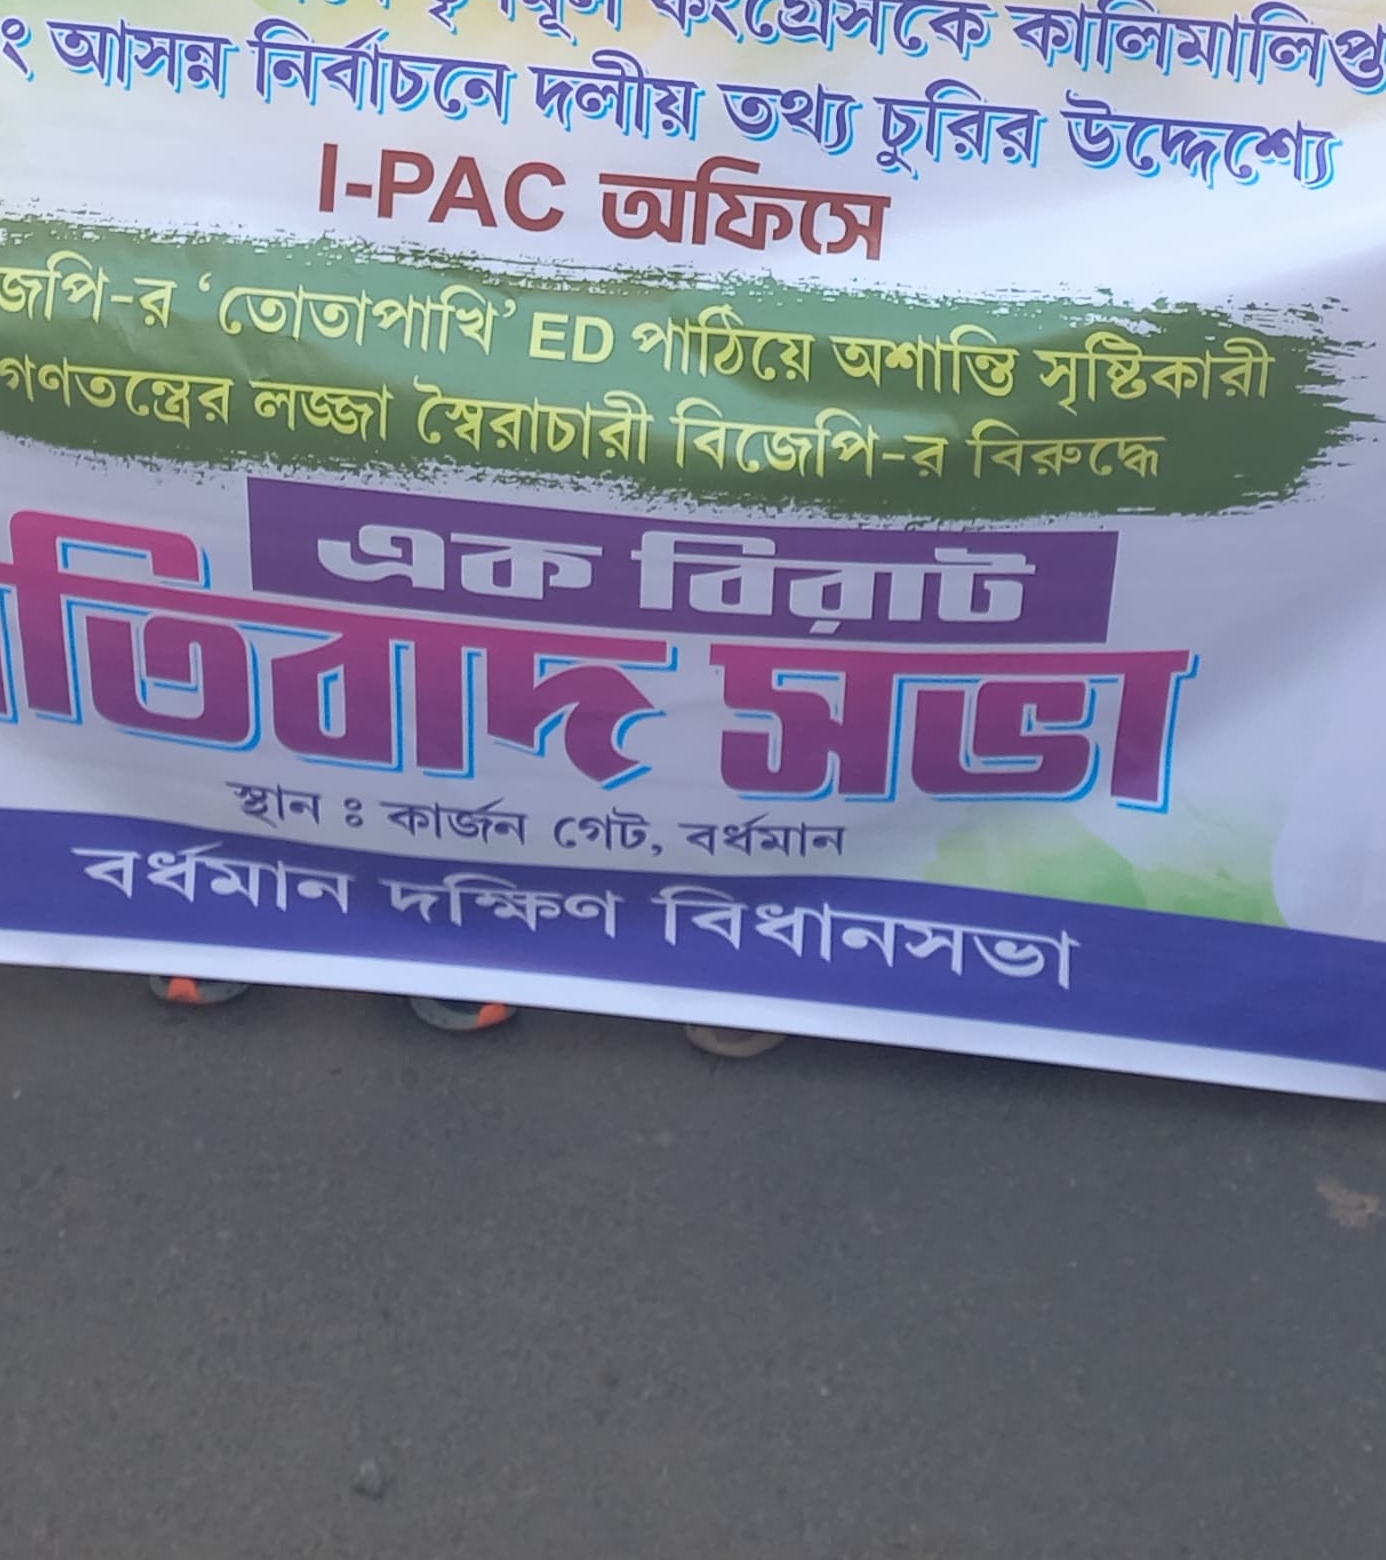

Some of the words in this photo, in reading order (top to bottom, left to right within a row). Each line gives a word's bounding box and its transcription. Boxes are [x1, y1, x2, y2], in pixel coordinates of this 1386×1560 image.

[46, 18, 240, 100] আসন্ন
[246, 15, 516, 123] নির্বাচনে
[528, 49, 706, 142] দলীয়
[716, 81, 862, 153] তথ্য
[874, 77, 1048, 181] চুরির
[1060, 89, 1344, 190] উদ্দেশ্যে
[318, 141, 566, 233] I-PAC
[599, 155, 892, 262] অফিসে
[529, 311, 615, 364] ED
[631, 302, 816, 385] পাঠিয়ে
[830, 322, 1020, 400] অশান্তি
[1034, 328, 1276, 417] সৃষ্টিকারী
[249, 378, 397, 441] লজ্জা
[413, 374, 655, 463] স্বৈরাচারী
[670, 395, 949, 480] বিজেপি-র
[966, 419, 1170, 480] বিরুদ্ধে
[317, 523, 603, 600] এক
[631, 530, 1036, 635] বিরাট
[709, 642, 1200, 815] সভা
[226, 780, 321, 828] স্থান
[379, 798, 528, 847] কার্জন
[554, 806, 664, 858] গেট,
[679, 811, 847, 858] বর্ধমান
[72, 841, 355, 916] বর্ধমান
[380, 871, 625, 942] দক্ষিণ
[651, 884, 1082, 991] বিধানসভা
